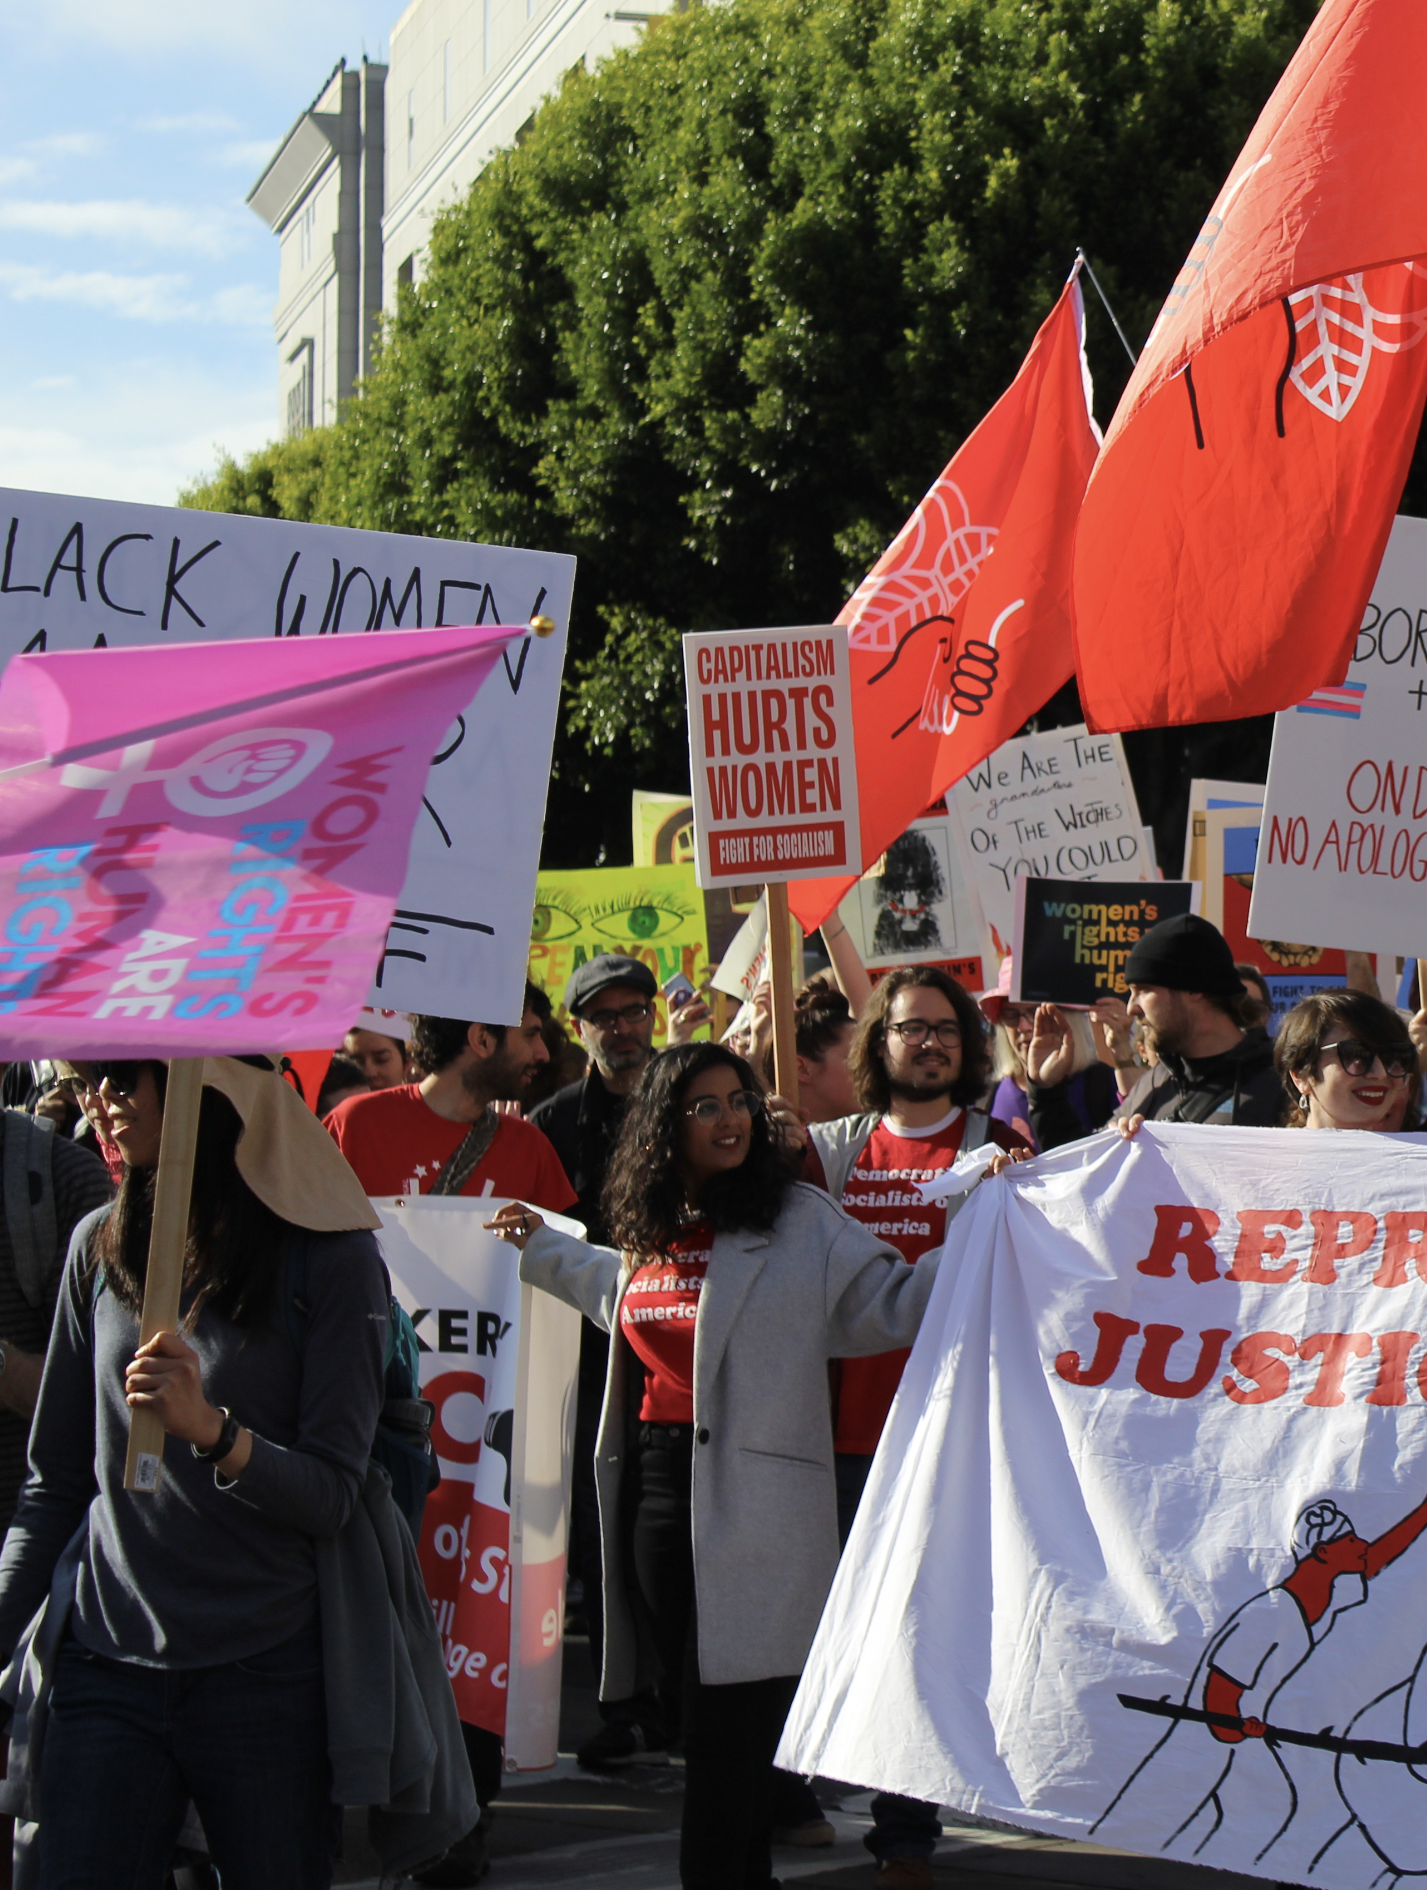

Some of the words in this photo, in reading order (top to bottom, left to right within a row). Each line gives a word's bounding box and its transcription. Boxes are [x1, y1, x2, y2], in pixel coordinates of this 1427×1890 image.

[0, 517, 222, 631] LACK
[697, 639, 836, 686] CAPITALISM
[702, 684, 837, 758] HURTS
[1020, 750, 1061, 782] ARE
[1063, 736, 1114, 768] THE
[706, 757, 842, 821] WOMEN
[1346, 759, 1409, 816] ON
[719, 837, 750, 865] FIGHT
[753, 834, 773, 862] FOR
[776, 830, 835, 860] SOCIALISM
[1006, 818, 1050, 844] THE
[1267, 815, 1309, 865] NO
[246, 745, 405, 1019] WOMEN'S
[989, 855, 1049, 892] YOU
[1056, 835, 1138, 875] COULD
[19, 822, 171, 1018] HUMAN
[173, 819, 309, 1019] RIGHTS
[1043, 900, 1158, 924] women's
[1063, 919, 1141, 947] rights
[91, 929, 198, 1020] ARE
[1075, 940, 1132, 966] hum
[1095, 971, 1129, 993] rig
[863, 1218, 930, 1236] merica
[622, 1302, 698, 1325] Americ
